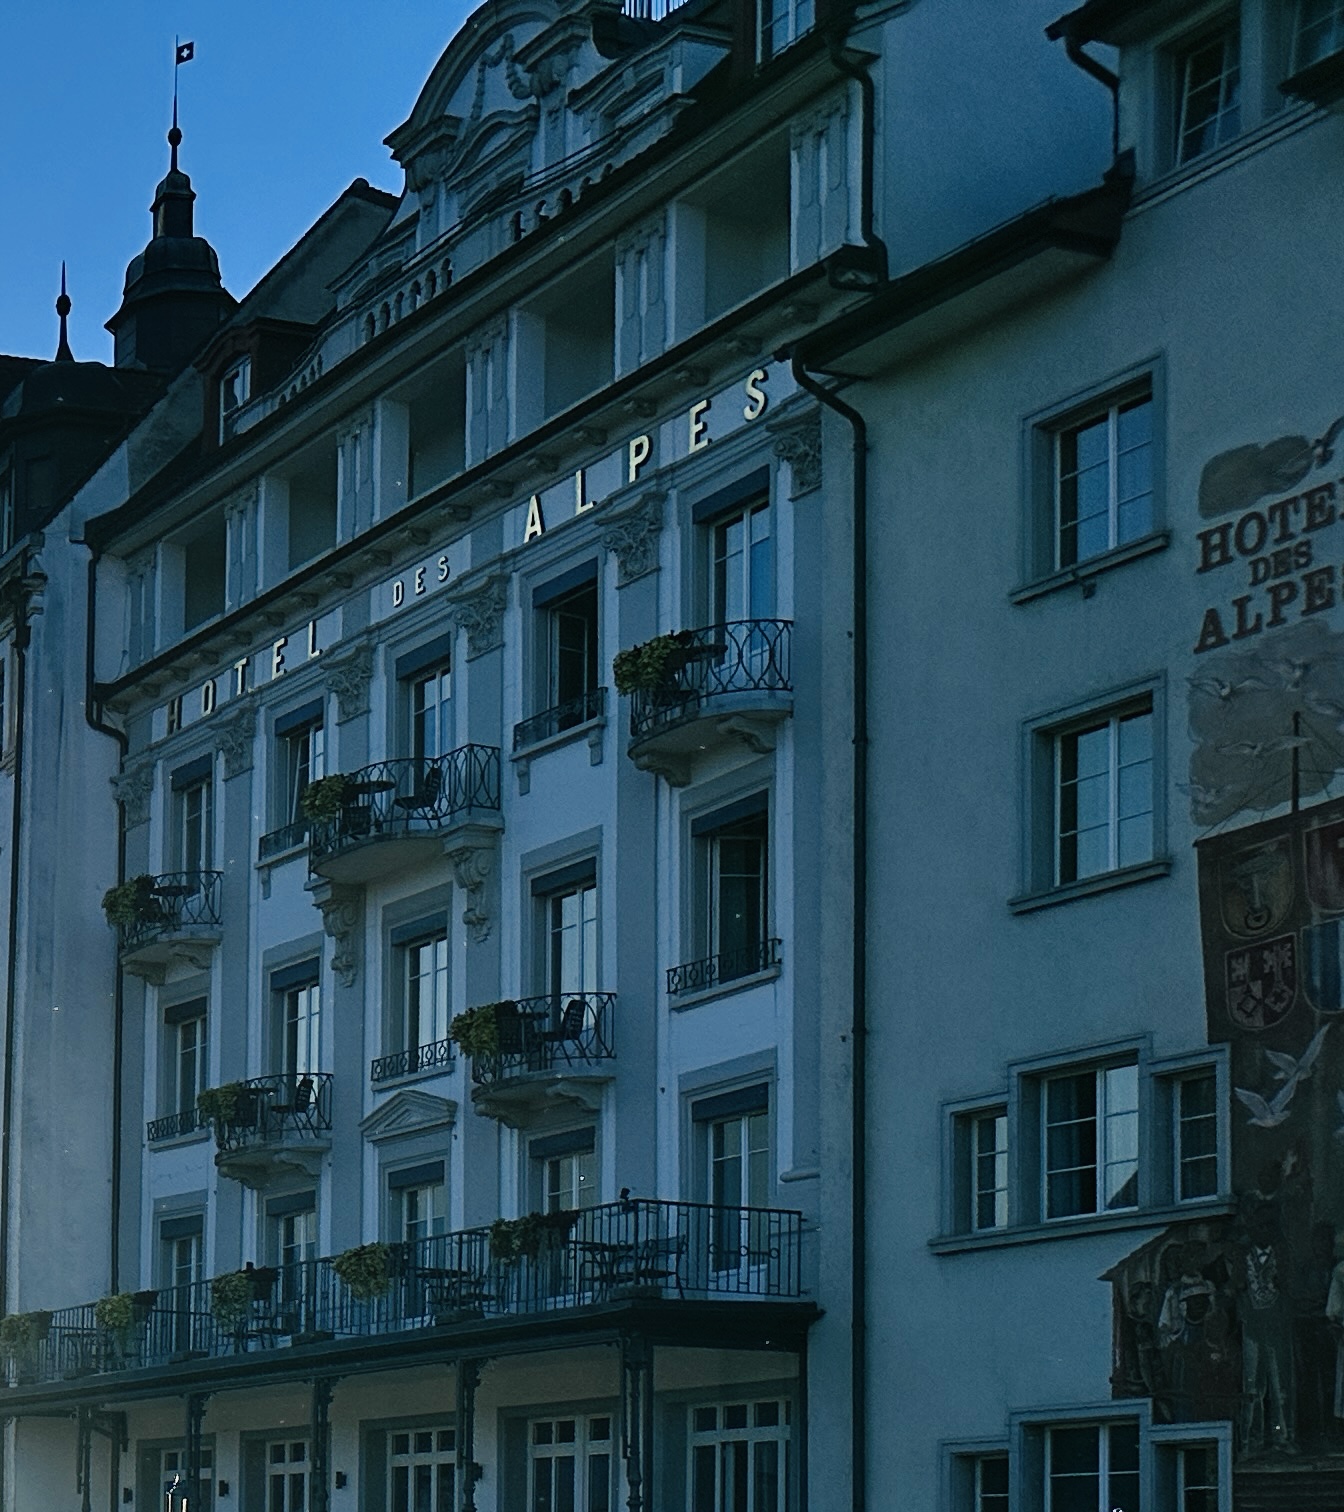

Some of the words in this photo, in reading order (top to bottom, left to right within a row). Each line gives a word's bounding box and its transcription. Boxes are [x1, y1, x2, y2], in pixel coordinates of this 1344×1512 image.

[168, 622, 323, 735] HOTEL
[393, 555, 451, 608] DES
[523, 369, 769, 544] ALPES
[1197, 477, 1344, 574] HOTE
[1250, 540, 1313, 586] DES
